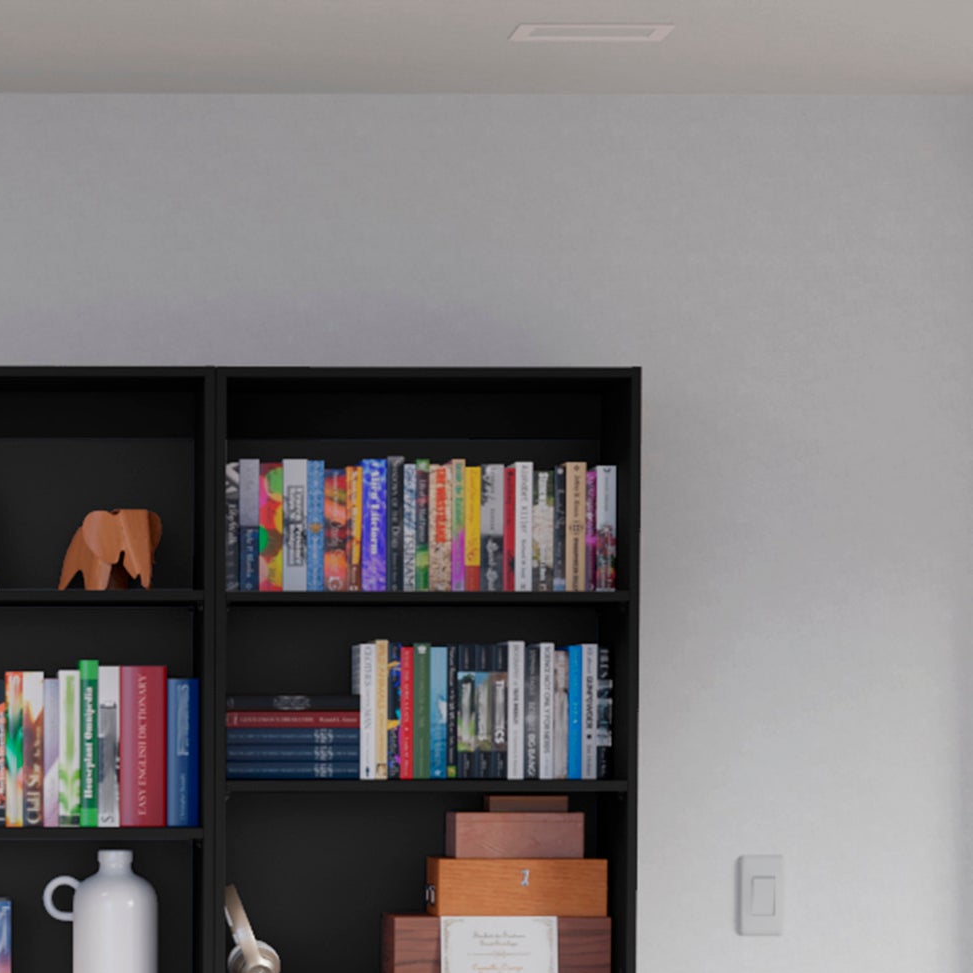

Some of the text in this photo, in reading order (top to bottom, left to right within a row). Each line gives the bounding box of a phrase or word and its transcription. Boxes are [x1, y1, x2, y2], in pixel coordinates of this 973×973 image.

[83, 685, 95, 799] Houseplant Omnipedia
[137, 673, 148, 816] EASY ENGLISH DICTIONARY
